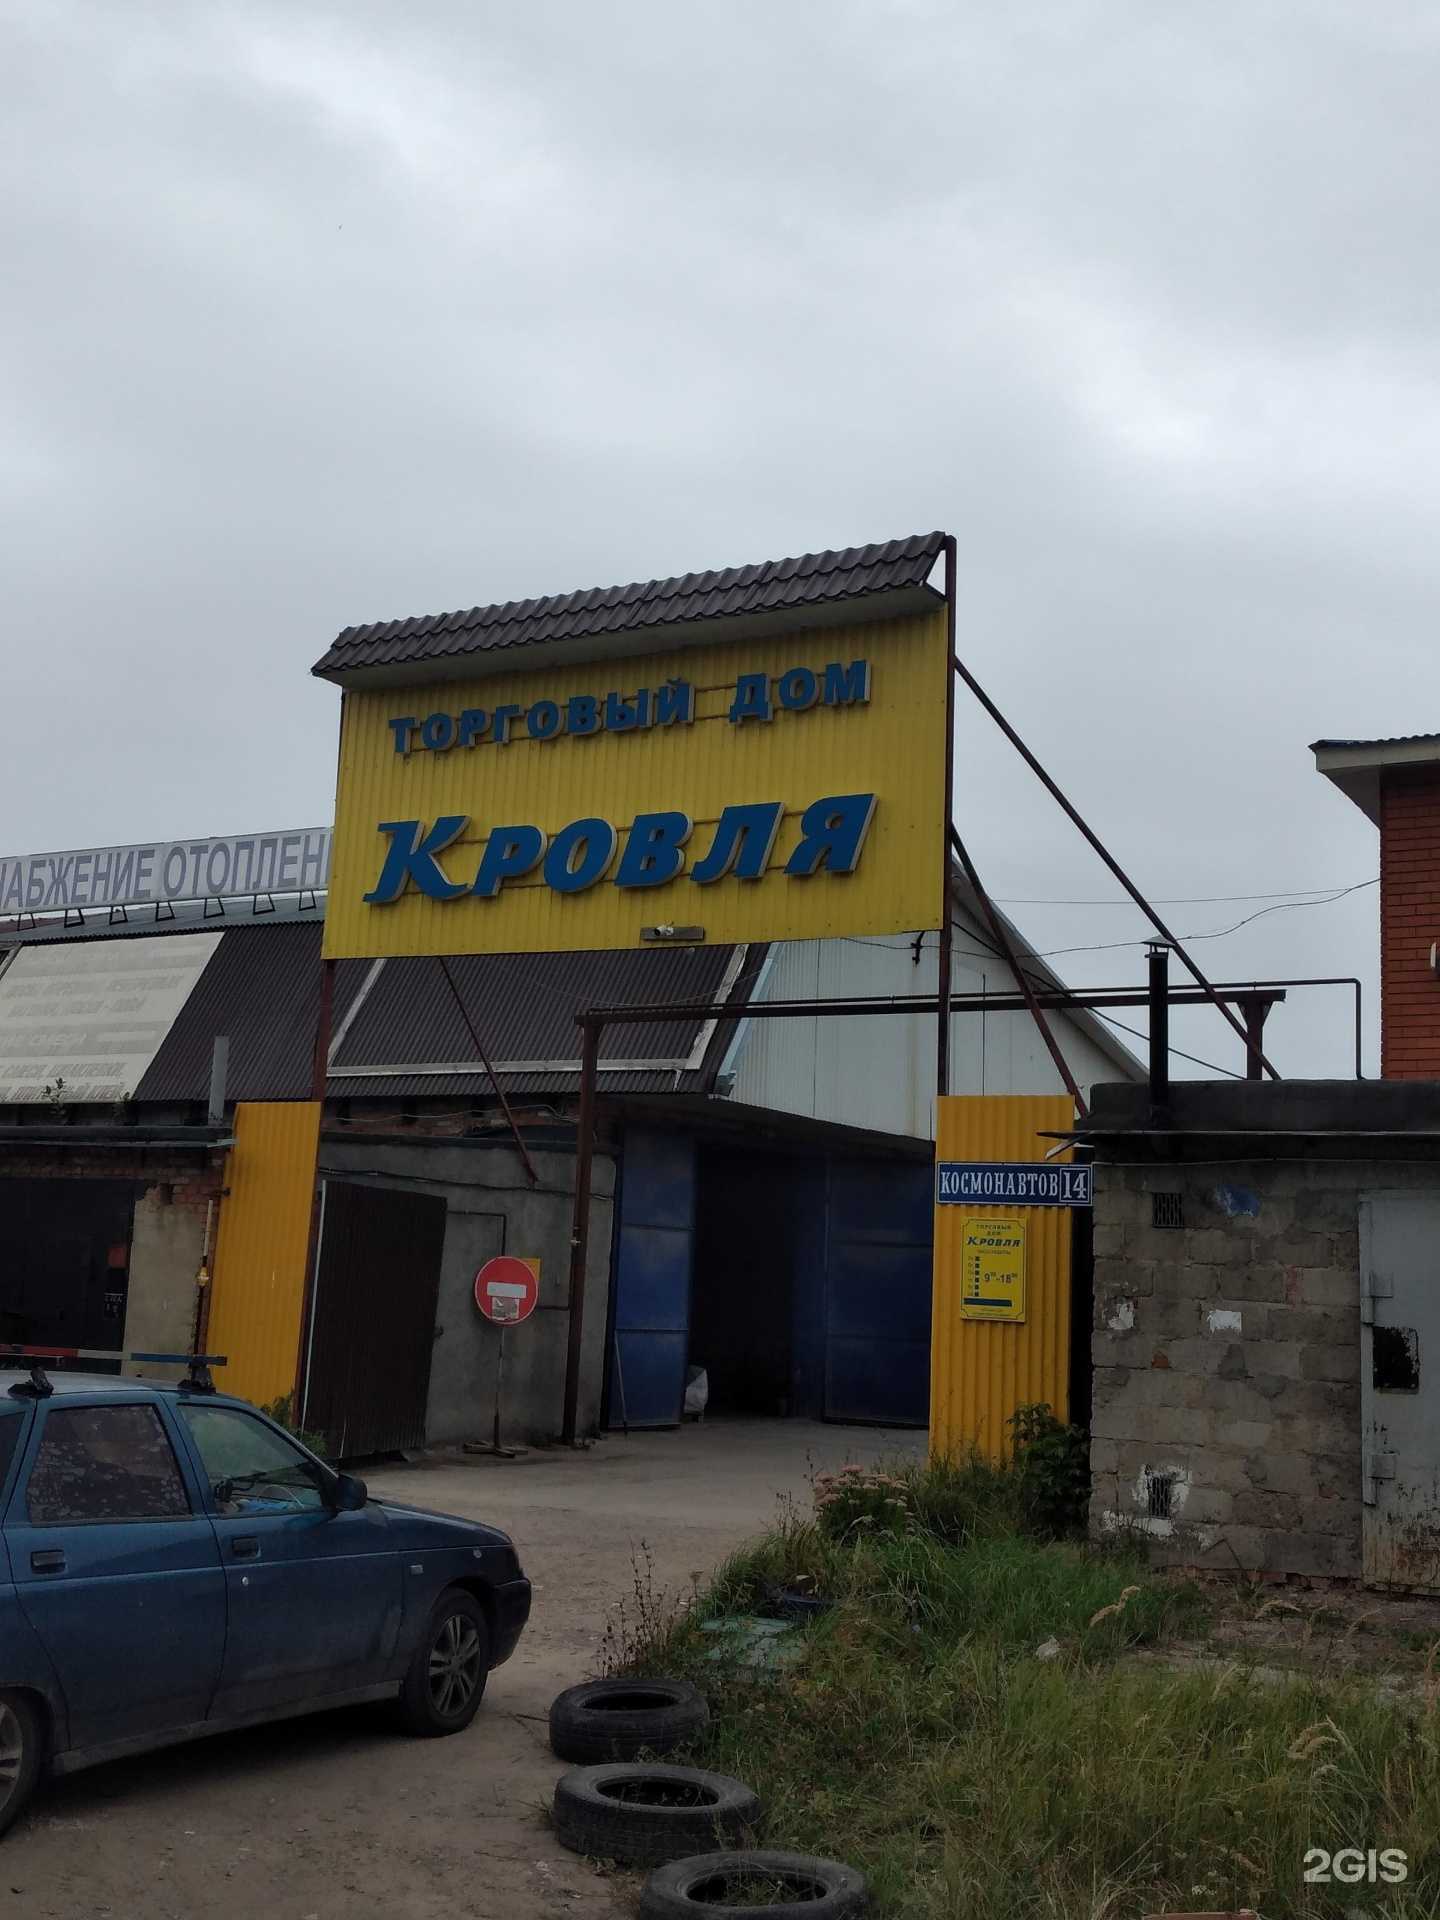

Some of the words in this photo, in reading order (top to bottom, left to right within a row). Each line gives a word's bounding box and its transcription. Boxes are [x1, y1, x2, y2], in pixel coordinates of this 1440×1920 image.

[389, 677, 697, 754] ТОРГОВЫЙ
[729, 659, 872, 723] ДОМ
[163, 832, 334, 898] ОТОПЛЕН
[940, 1171, 1059, 1197] КОСМОНАВТОВ
[1063, 1171, 1087, 1199] 14
